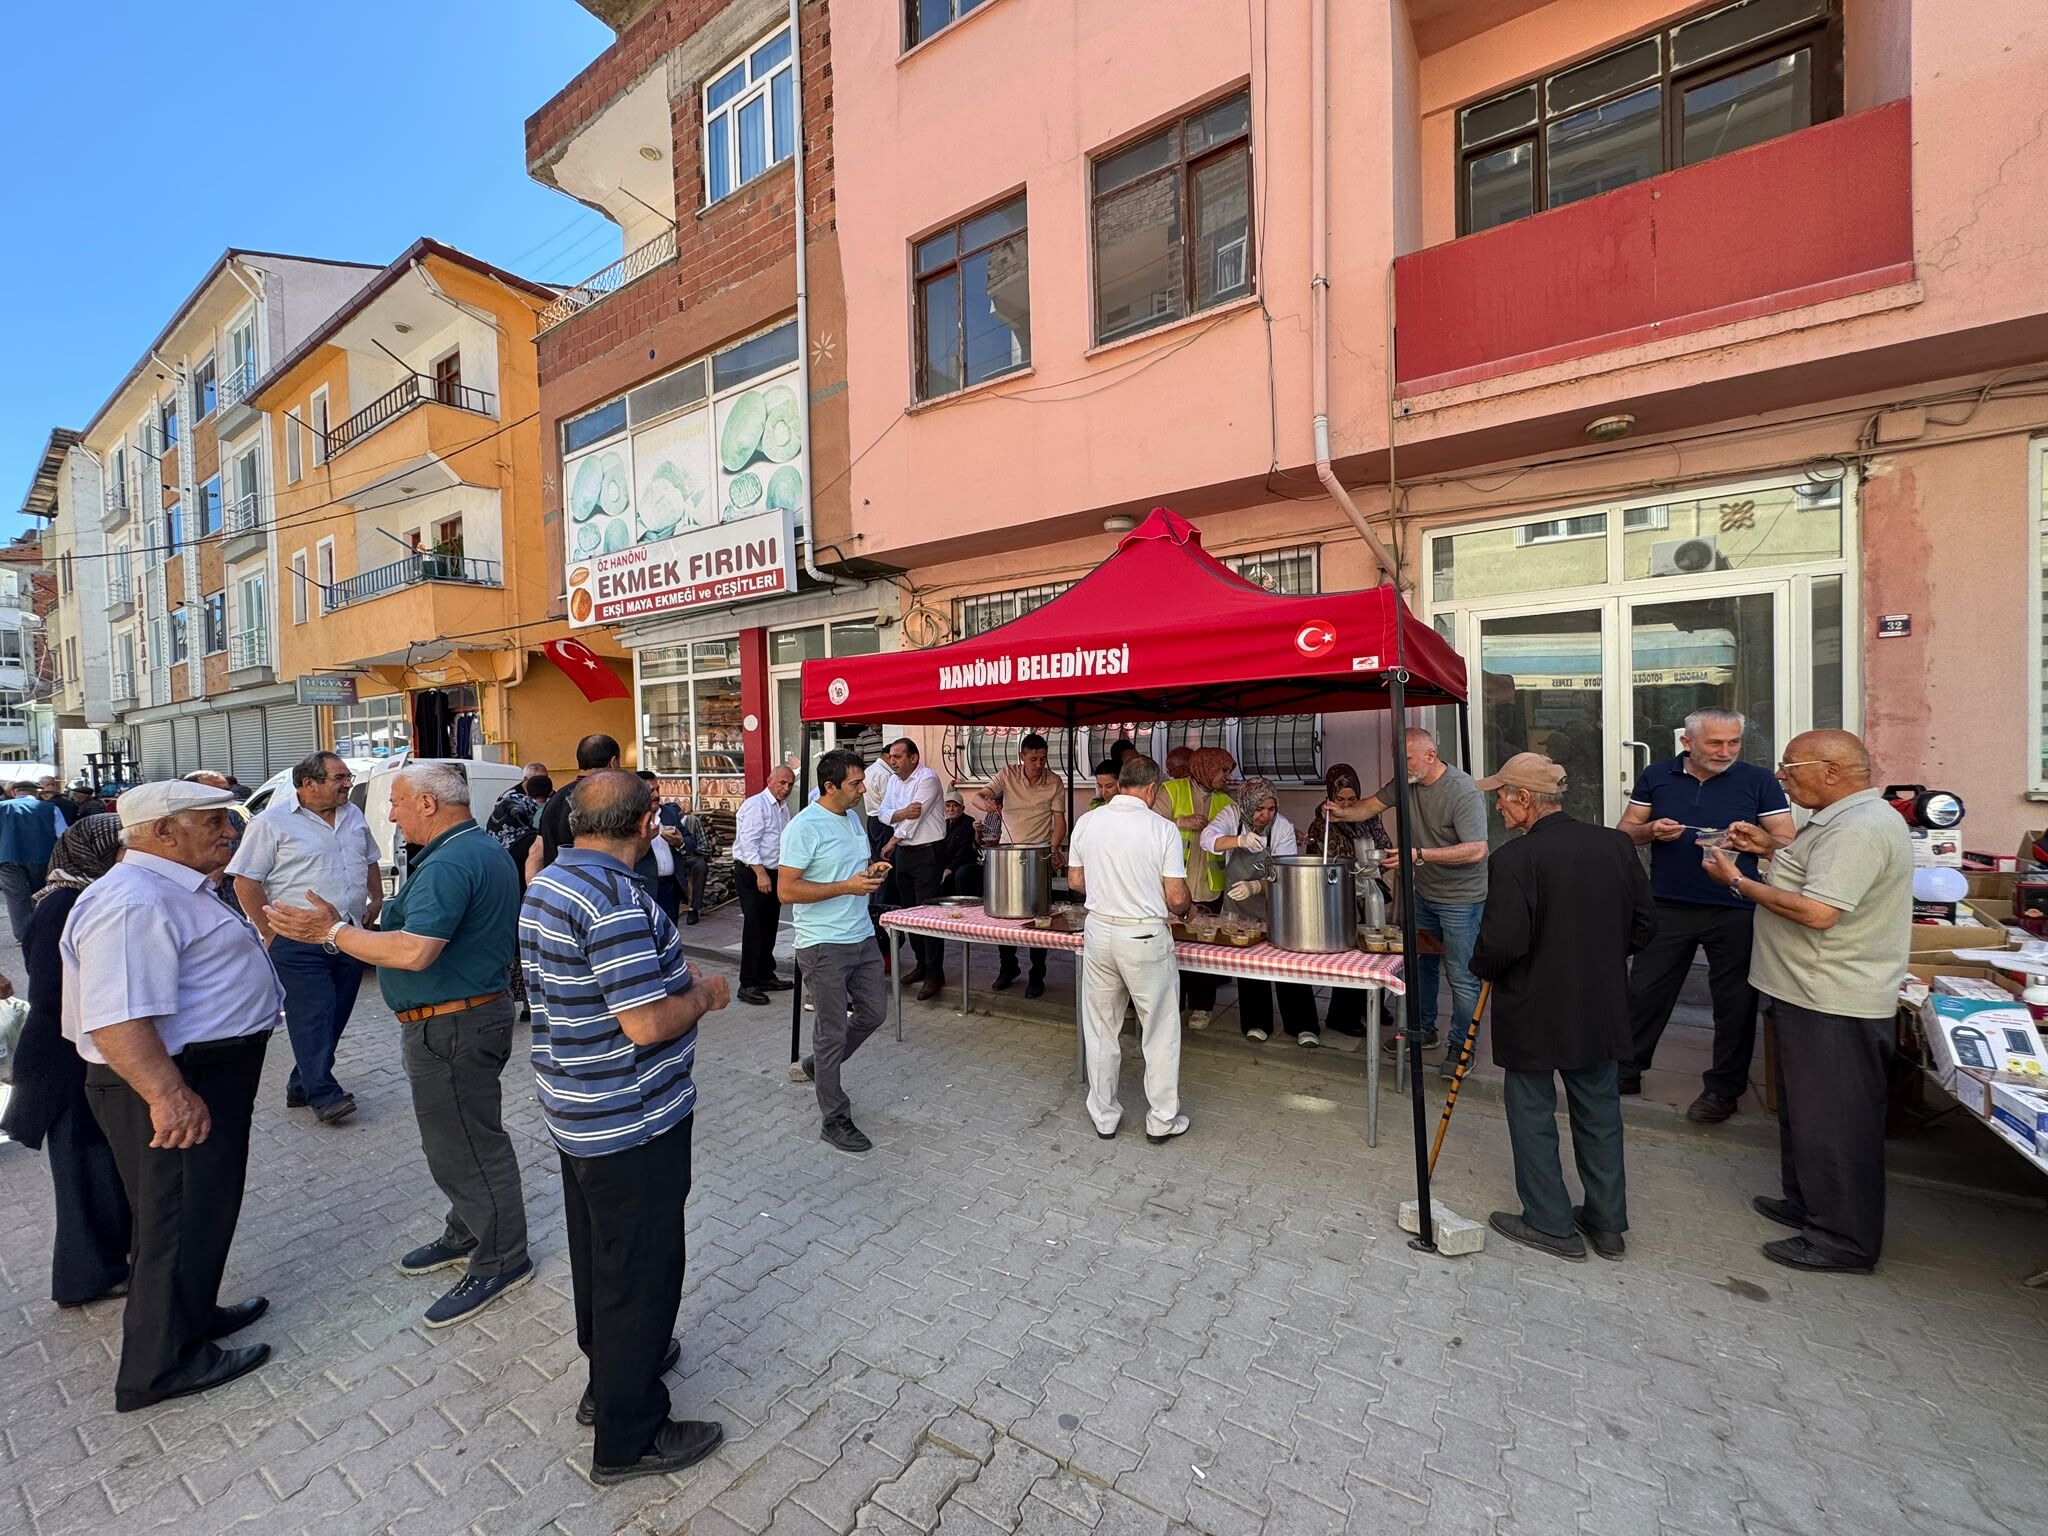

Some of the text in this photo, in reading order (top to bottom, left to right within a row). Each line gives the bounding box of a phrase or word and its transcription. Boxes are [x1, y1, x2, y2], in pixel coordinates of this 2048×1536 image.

[598, 548, 648, 572] ÖZ HANÖNÜ
[598, 537, 777, 599] EKMEK FIRINI
[602, 571, 777, 618] EKŞİ MAYA EKMEĞİ ve ÇEŞİTLERİ
[1887, 621, 1903, 631] 32
[938, 643, 1130, 690] HANÖNÜ BELEDİYESİ
